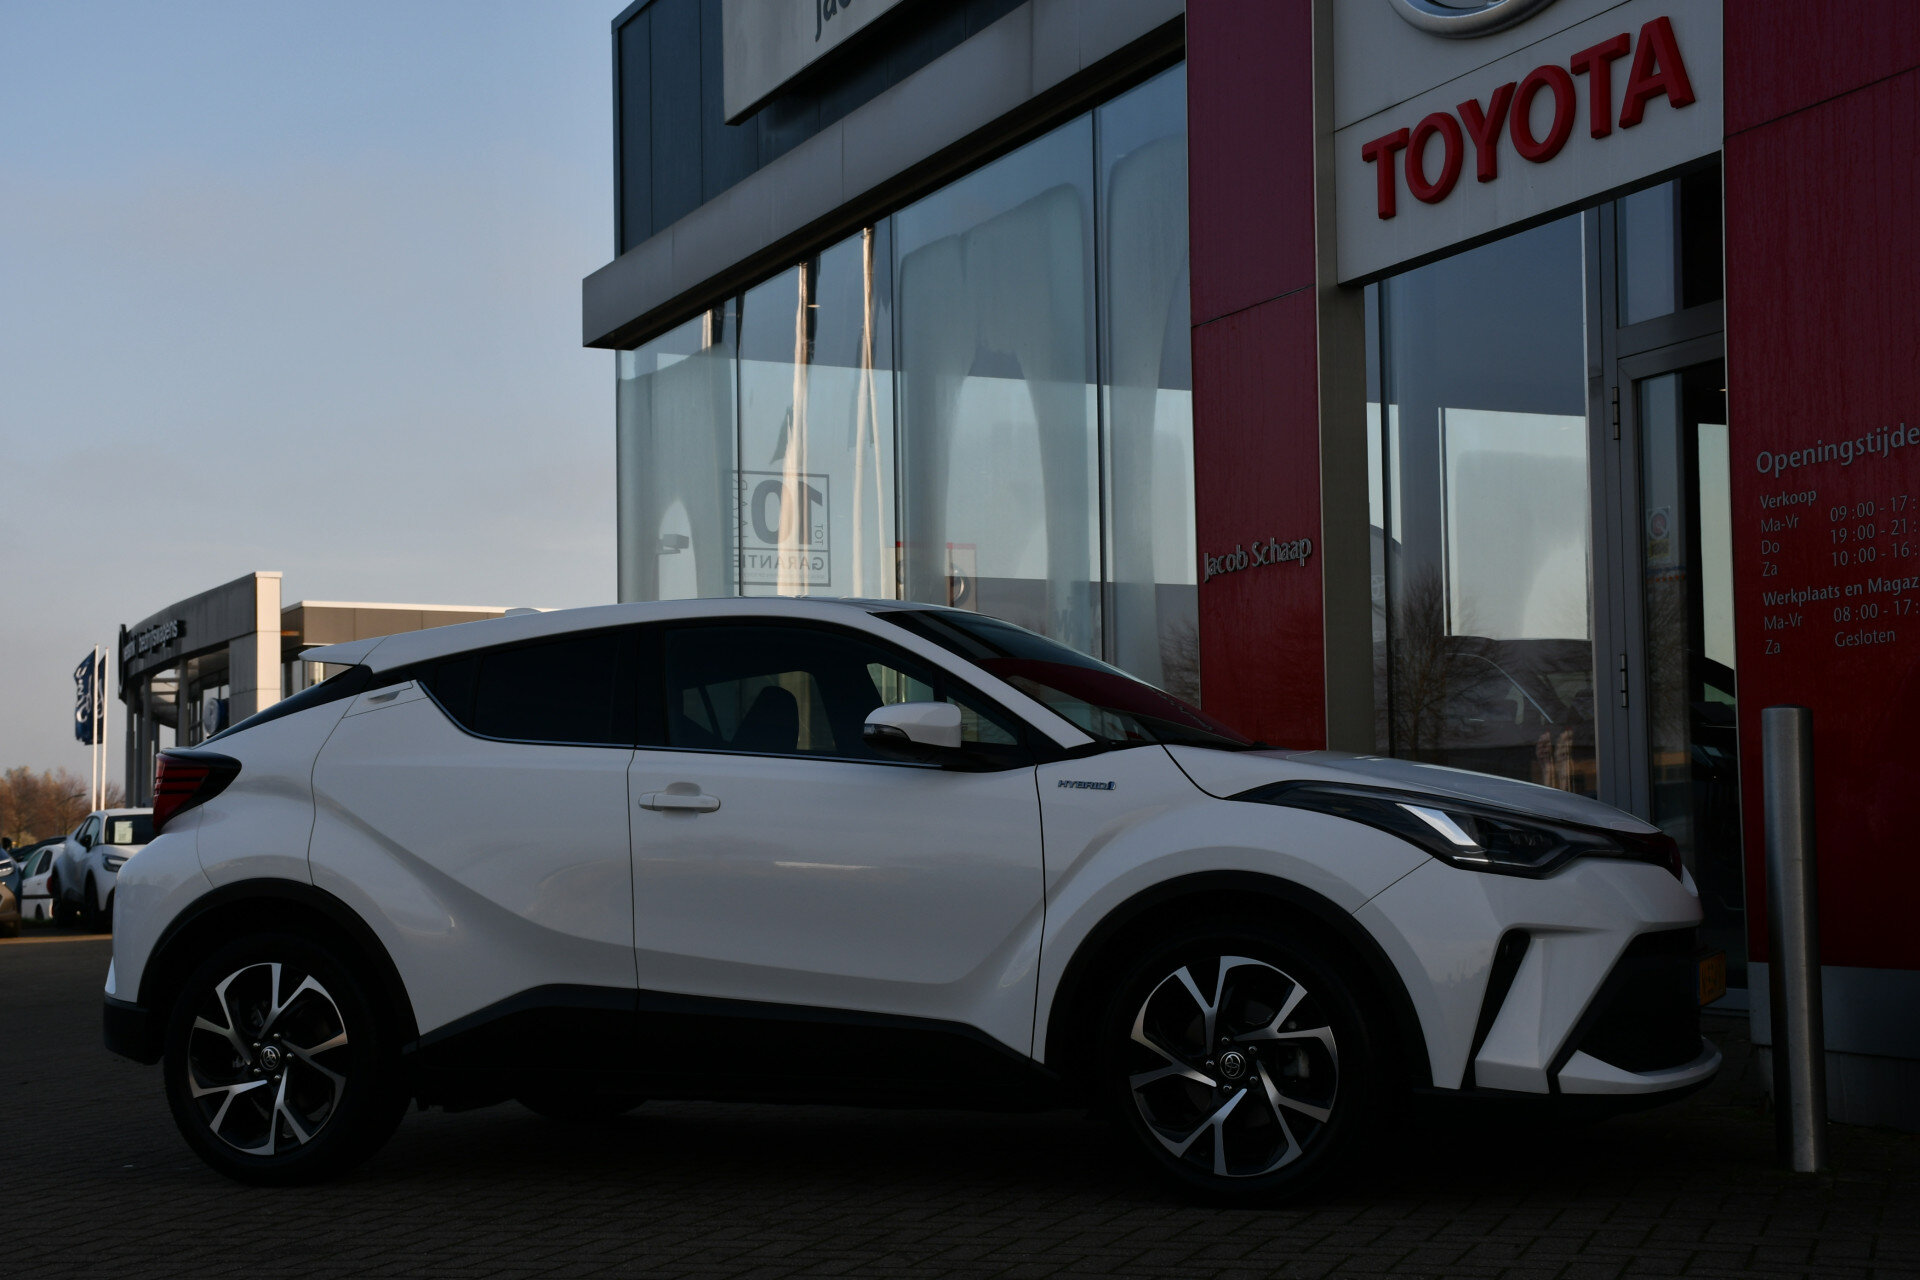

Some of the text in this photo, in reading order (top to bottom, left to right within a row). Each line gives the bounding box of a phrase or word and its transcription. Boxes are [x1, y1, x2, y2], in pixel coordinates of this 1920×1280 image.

[1362, 16, 1695, 219] TOYOTA
[1756, 423, 1920, 478] Openingstijde
[1760, 490, 1817, 510] Verkoop
[1761, 514, 1799, 533] Ma-Vr
[1761, 540, 1780, 555] Do
[1203, 537, 1312, 583] Jacob Schaap
[1762, 562, 1778, 577] Za
[1762, 585, 1840, 607] Werkplaats
[1845, 583, 1863, 597] en
[1764, 612, 1803, 631] Ma-Vr
[1765, 628, 1896, 655] Za Gesloten
[1058, 780, 1107, 790] HYBRID
